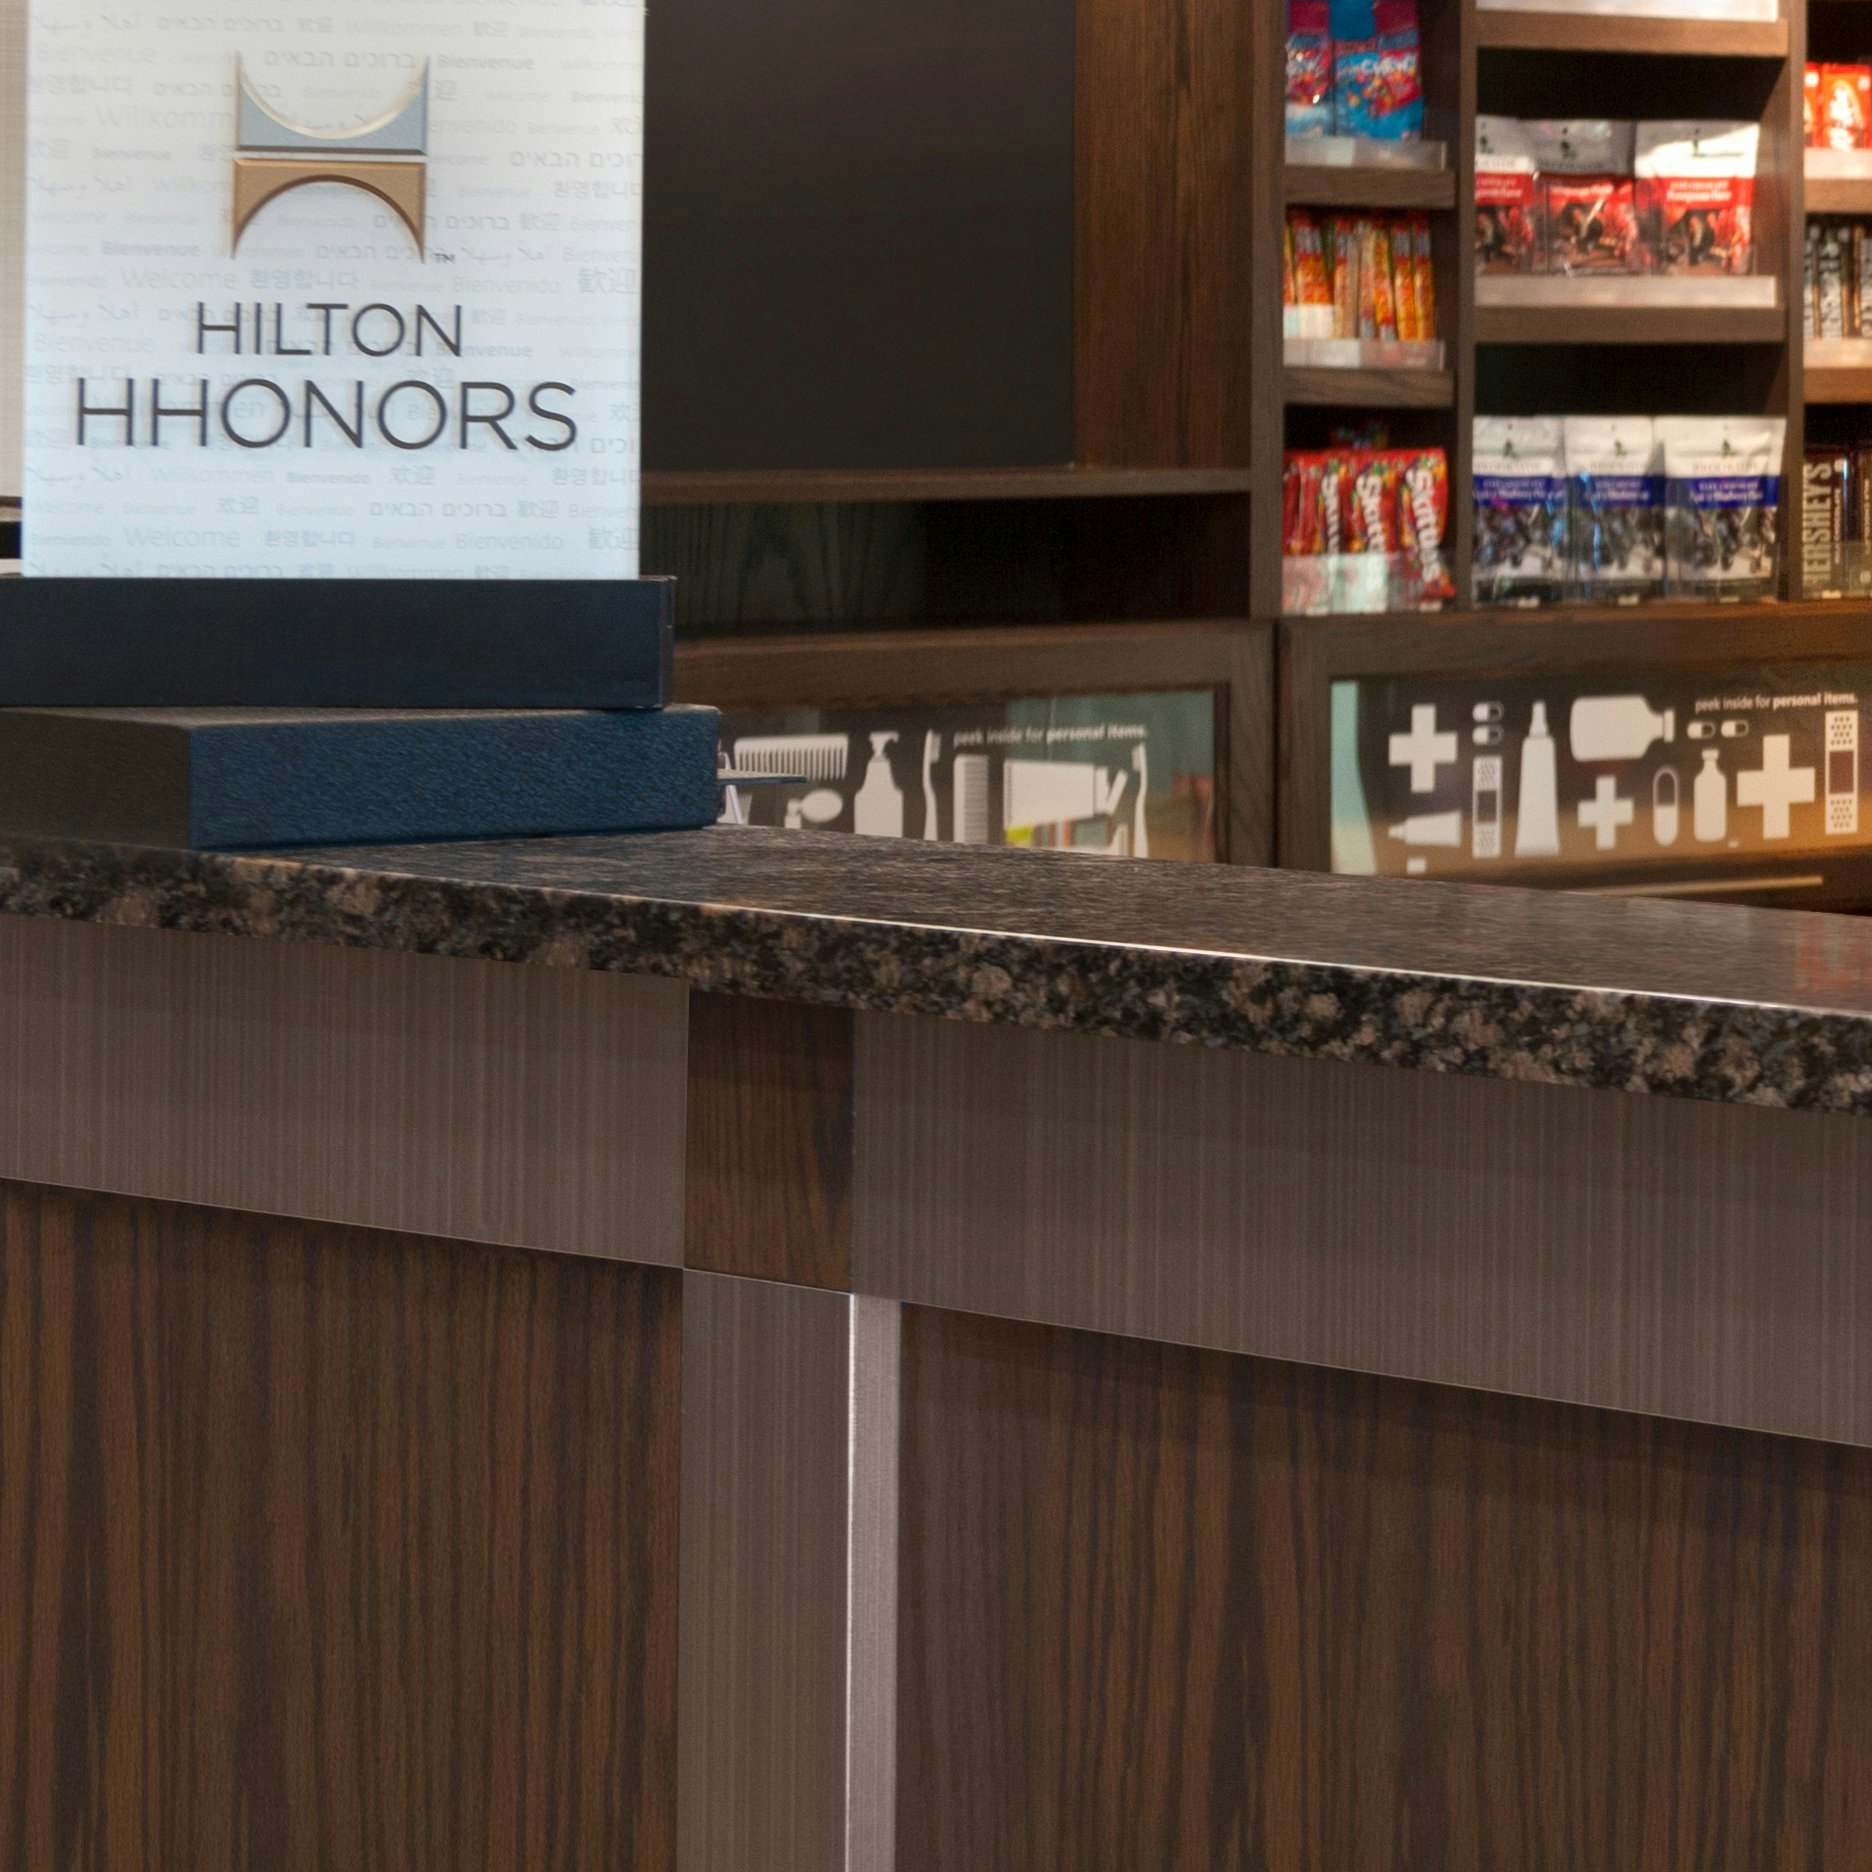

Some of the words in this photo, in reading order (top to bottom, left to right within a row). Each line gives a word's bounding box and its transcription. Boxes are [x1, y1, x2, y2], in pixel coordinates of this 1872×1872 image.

[197, 301, 462, 358] HILTON
[75, 377, 578, 452] HHONORS
[1695, 697, 1721, 715] peek
[1723, 695, 1753, 711] inside
[1755, 694, 1771, 709] for
[1772, 691, 1822, 711] personal
[953, 728, 984, 748] peek
[986, 726, 1024, 744] inside
[1026, 725, 1045, 743] for
[1046, 723, 1105, 745] personal
